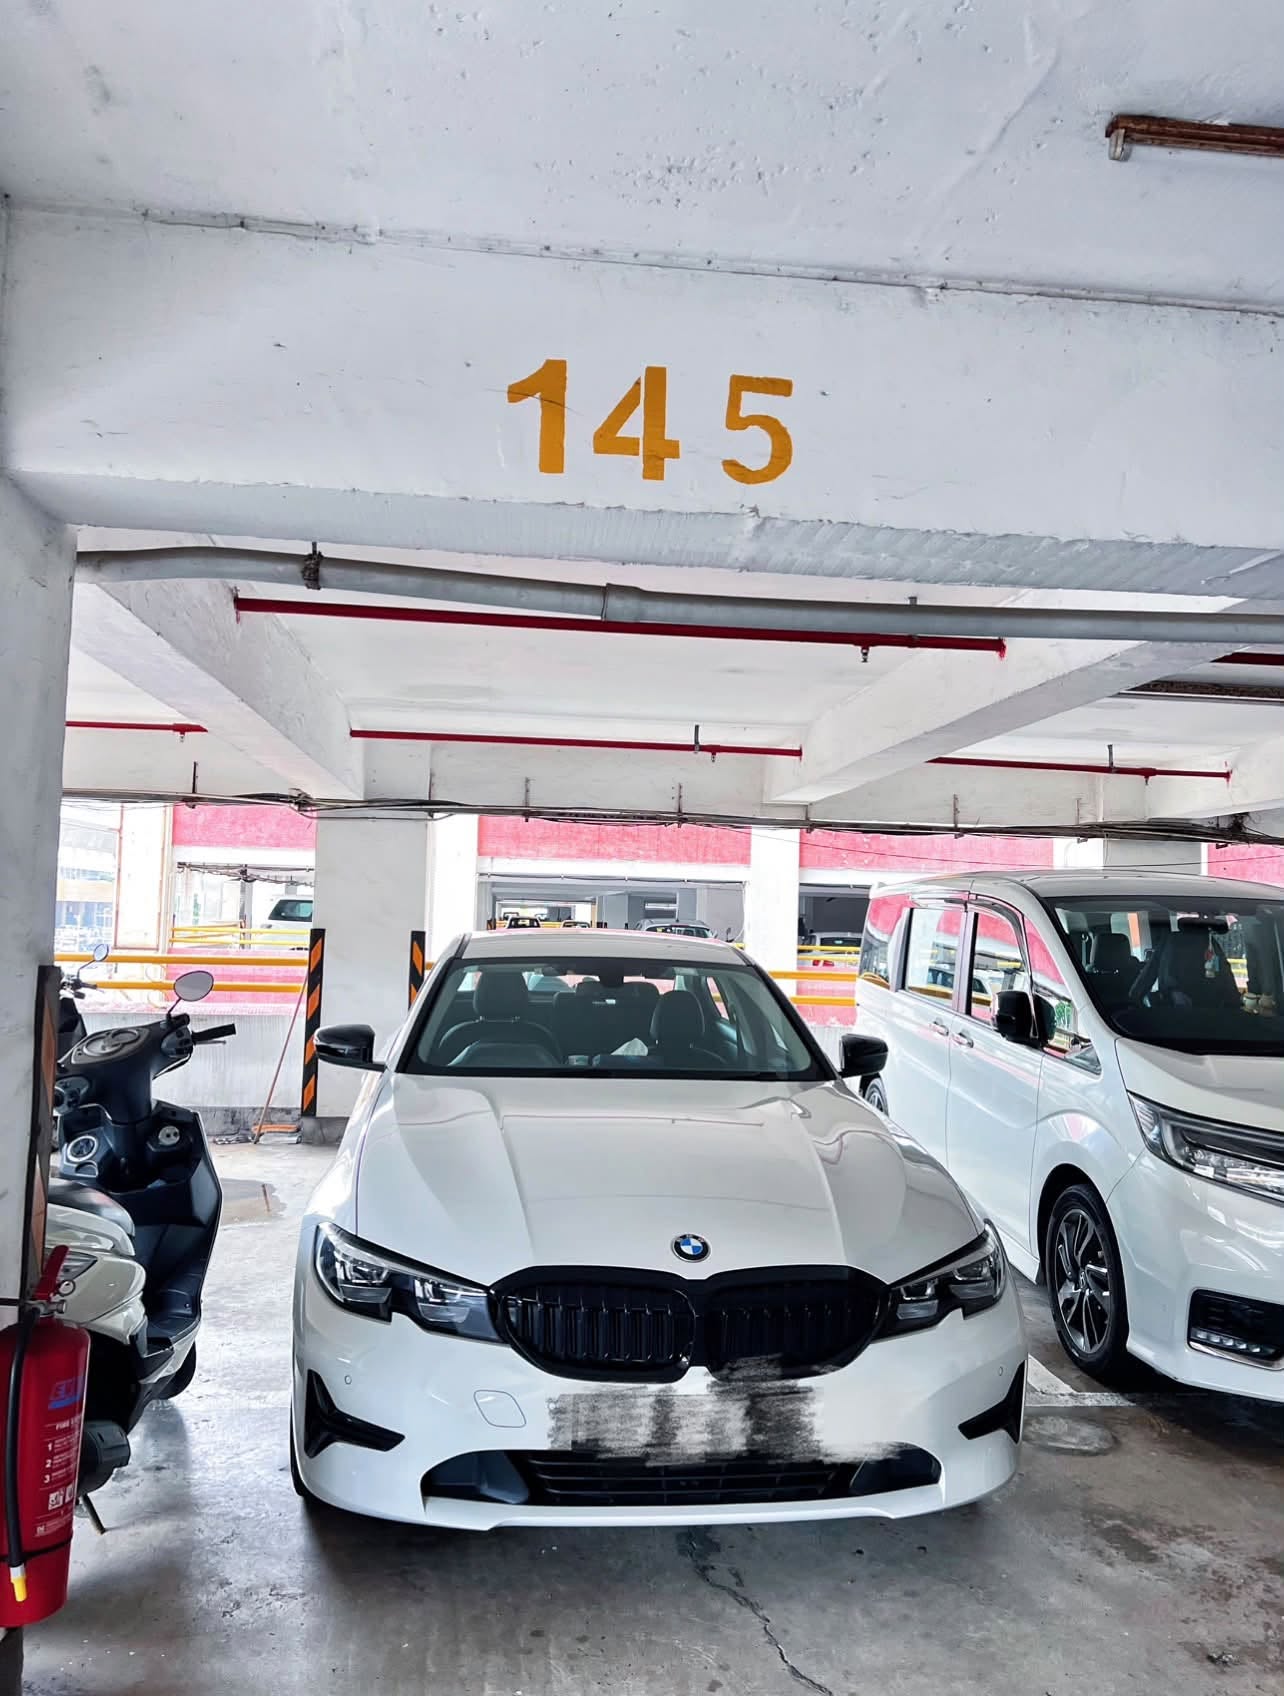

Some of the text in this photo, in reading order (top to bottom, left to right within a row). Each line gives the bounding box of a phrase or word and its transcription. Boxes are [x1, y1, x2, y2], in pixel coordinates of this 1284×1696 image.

[507, 359, 793, 484] 145
[45, 1459, 52, 1468] 2
[44, 1474, 51, 1484] 3
